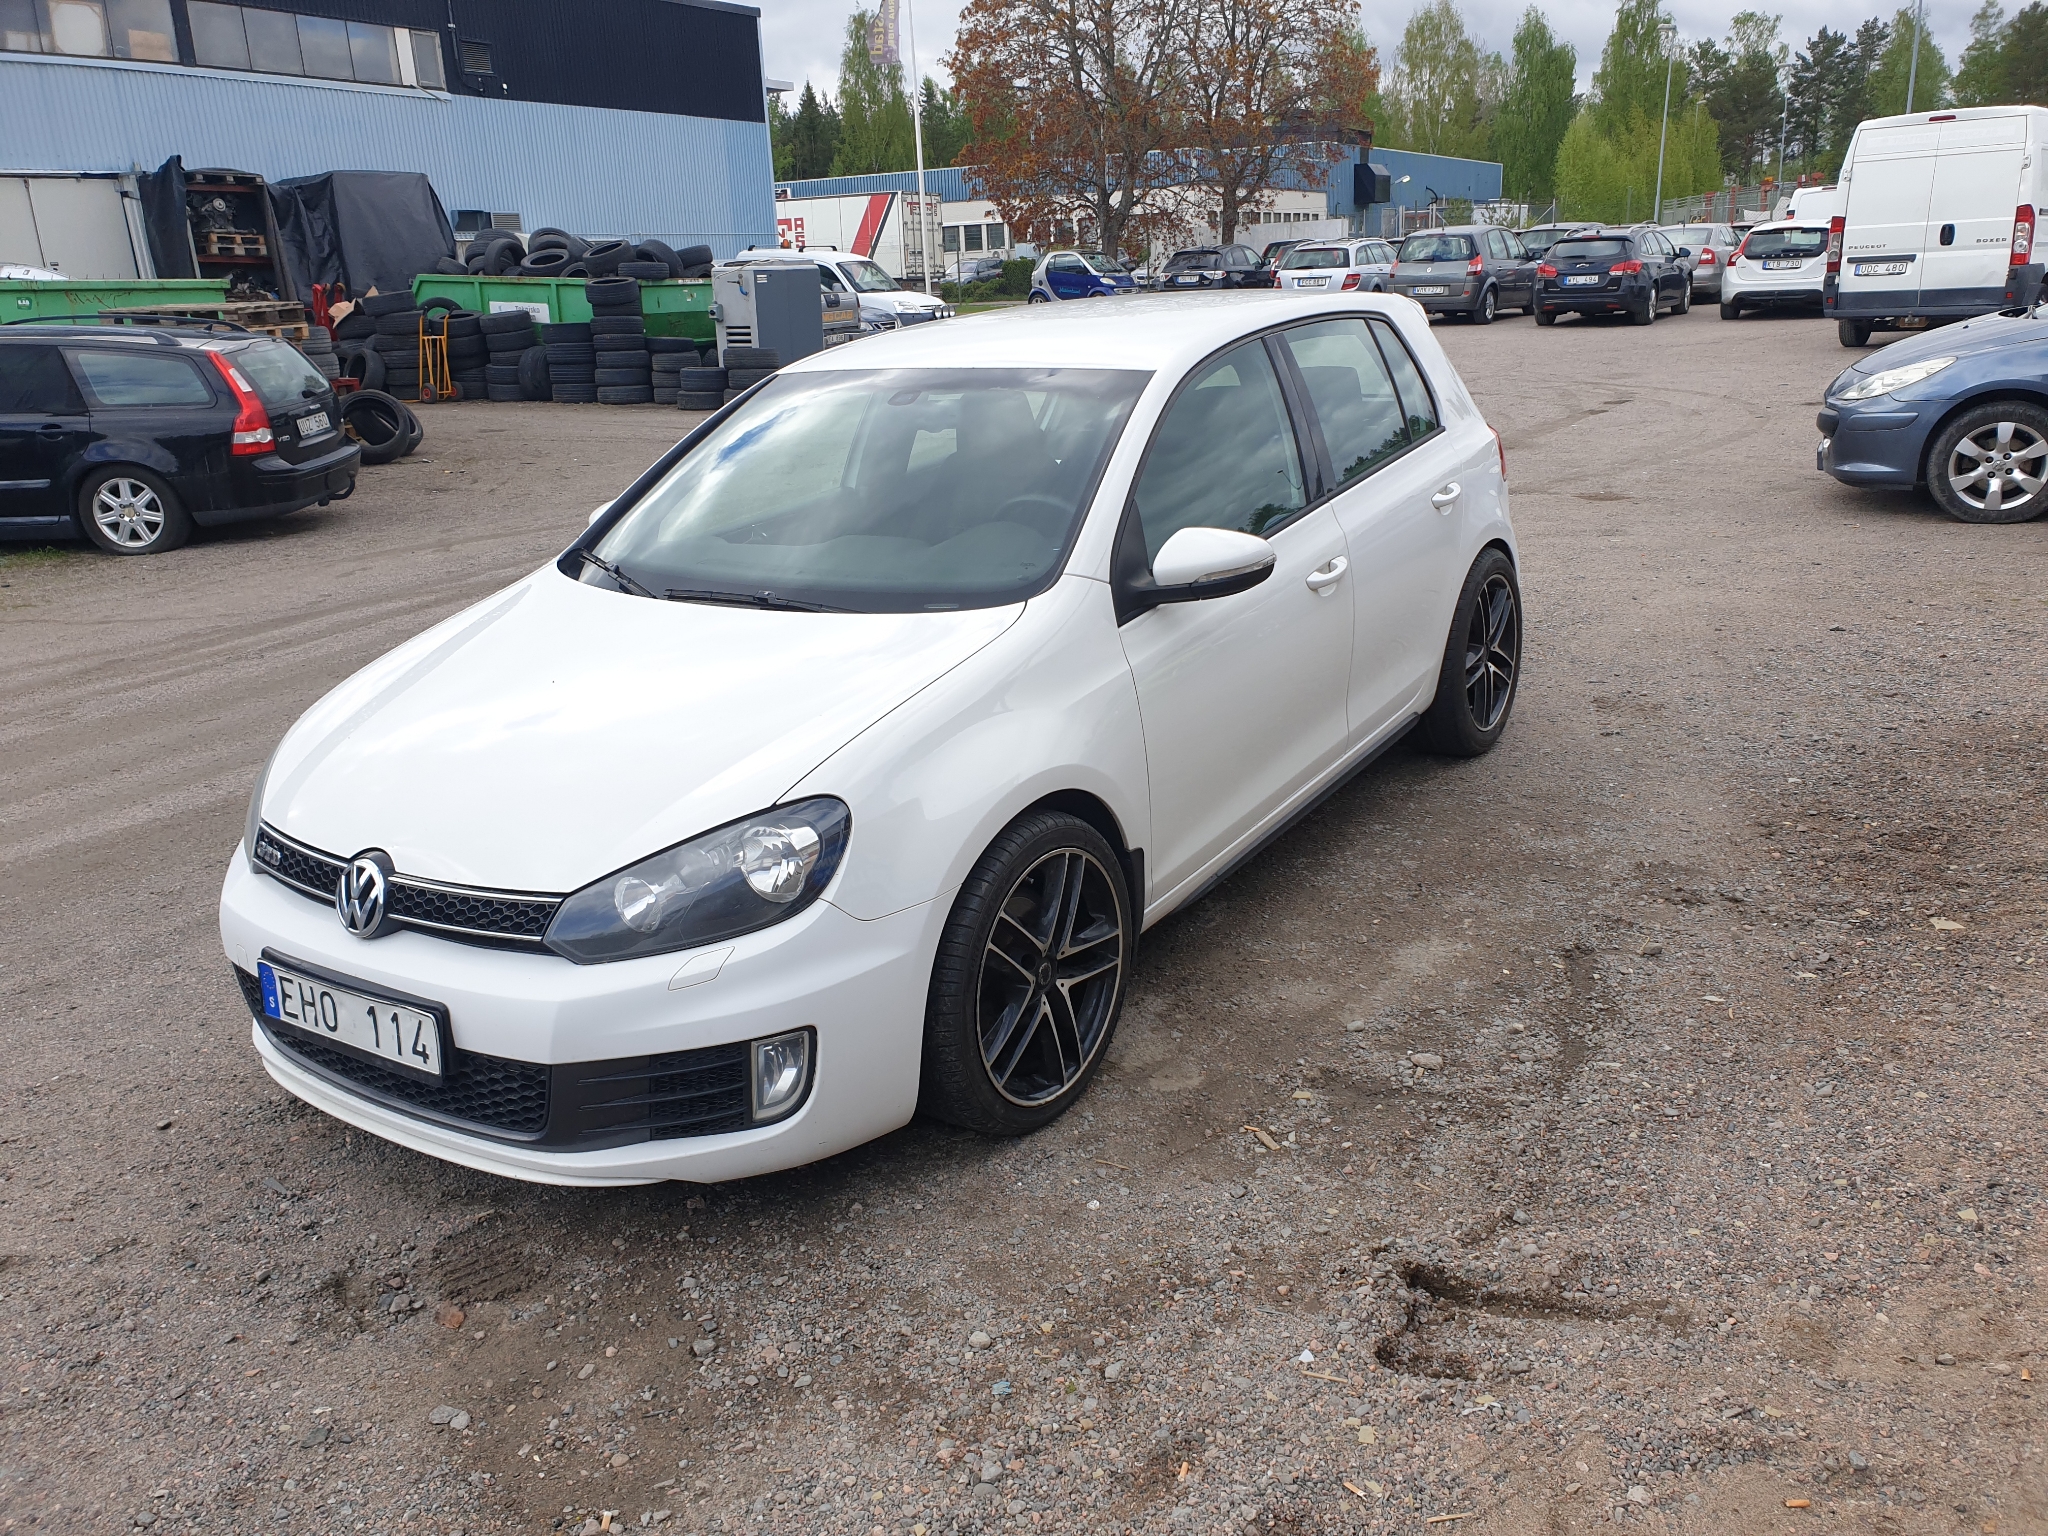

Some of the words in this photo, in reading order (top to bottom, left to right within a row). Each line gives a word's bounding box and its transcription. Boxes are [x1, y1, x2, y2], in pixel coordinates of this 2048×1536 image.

[1885, 263, 1905, 272] 480
[313, 413, 328, 428] 560
[336, 858, 385, 938] VW
[278, 975, 338, 1033] EHO
[366, 1004, 430, 1065] 114
